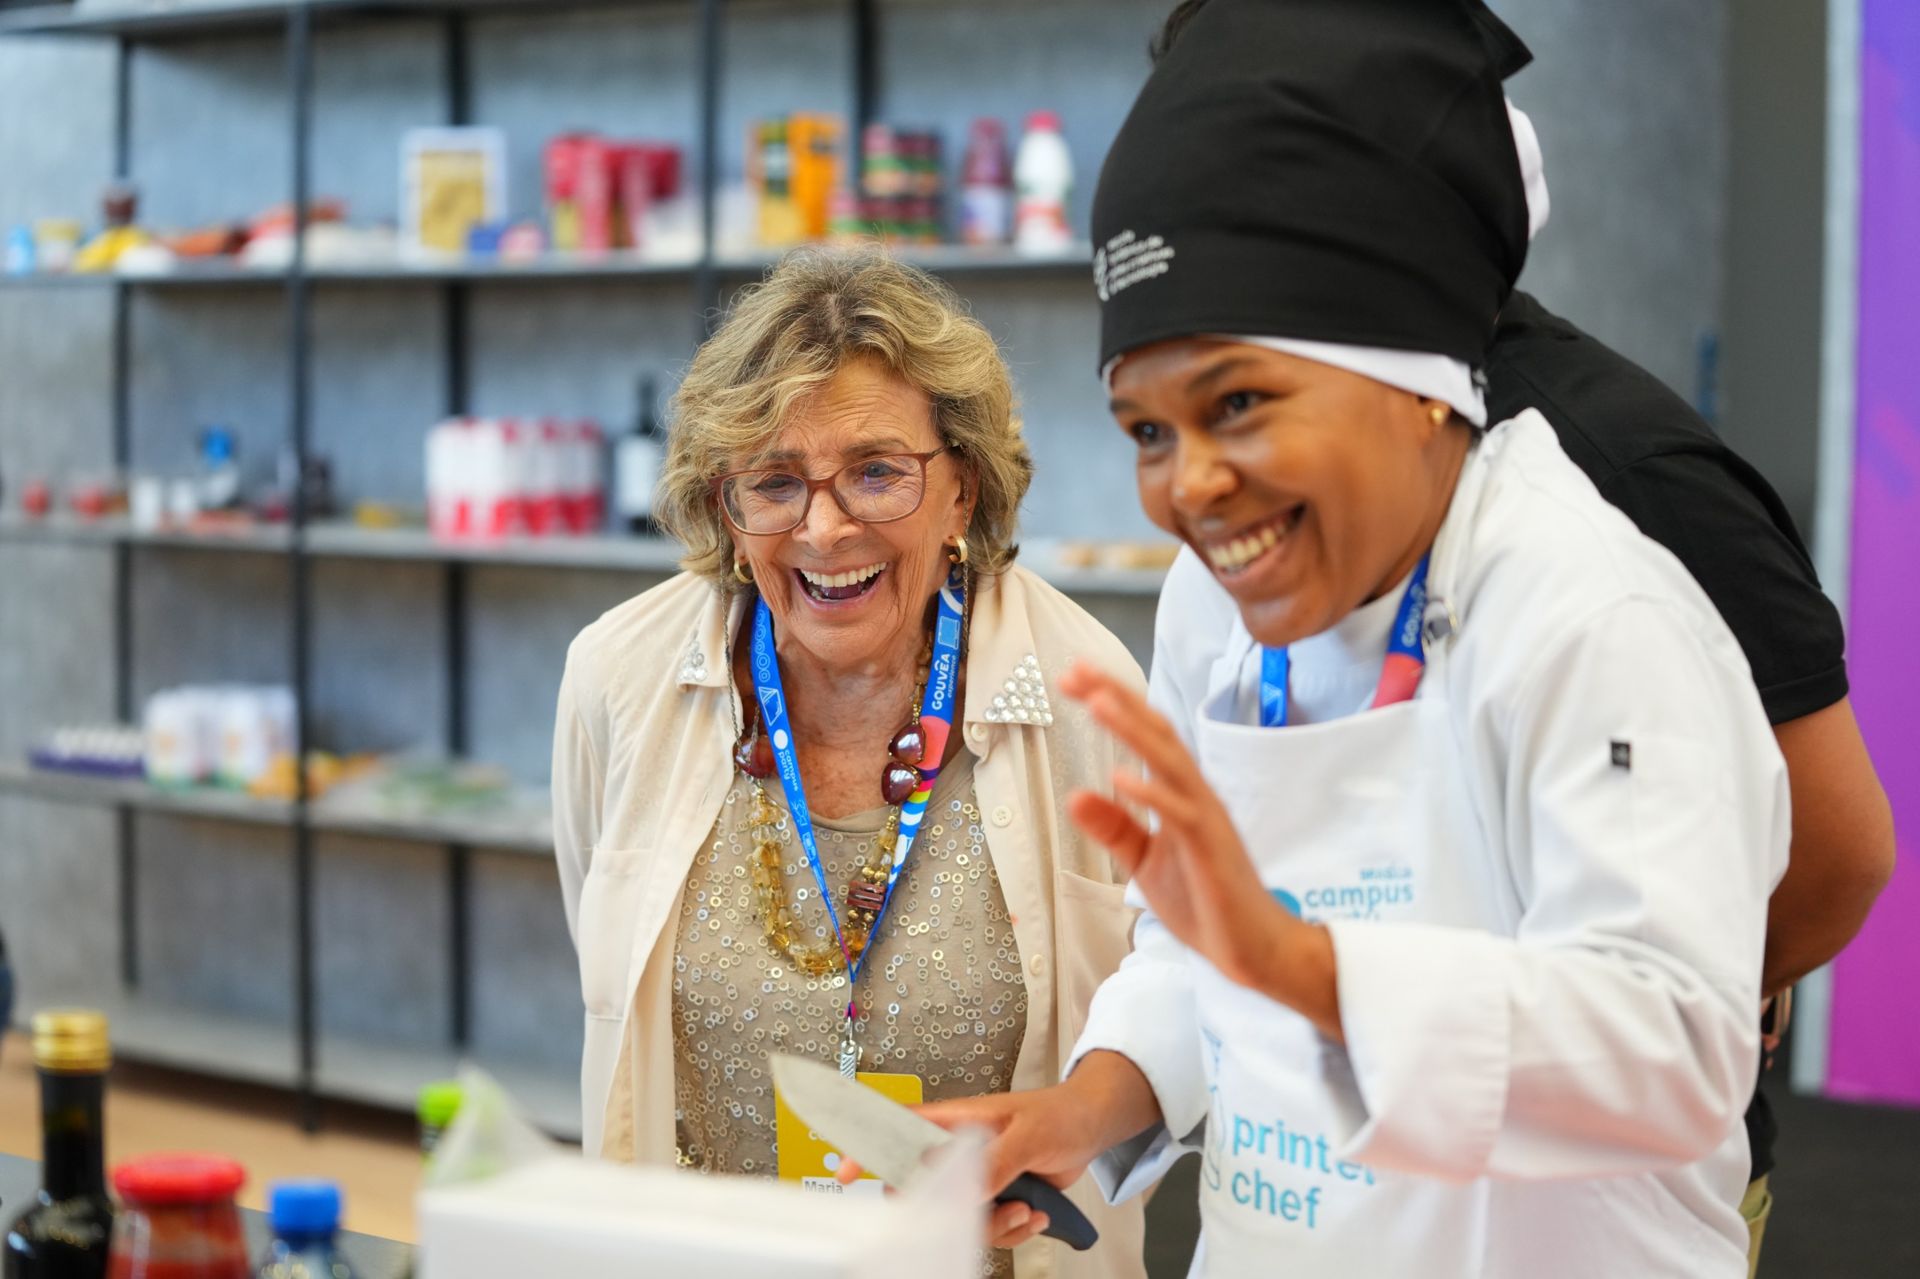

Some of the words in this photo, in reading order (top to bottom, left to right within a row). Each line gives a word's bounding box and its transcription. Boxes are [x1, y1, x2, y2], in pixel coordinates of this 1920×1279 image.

[778, 751, 791, 780] party
[784, 749, 799, 791] campus
[1304, 883, 1414, 913] campus
[804, 1180, 844, 1194] Maria
[1231, 1168, 1321, 1229] chef
